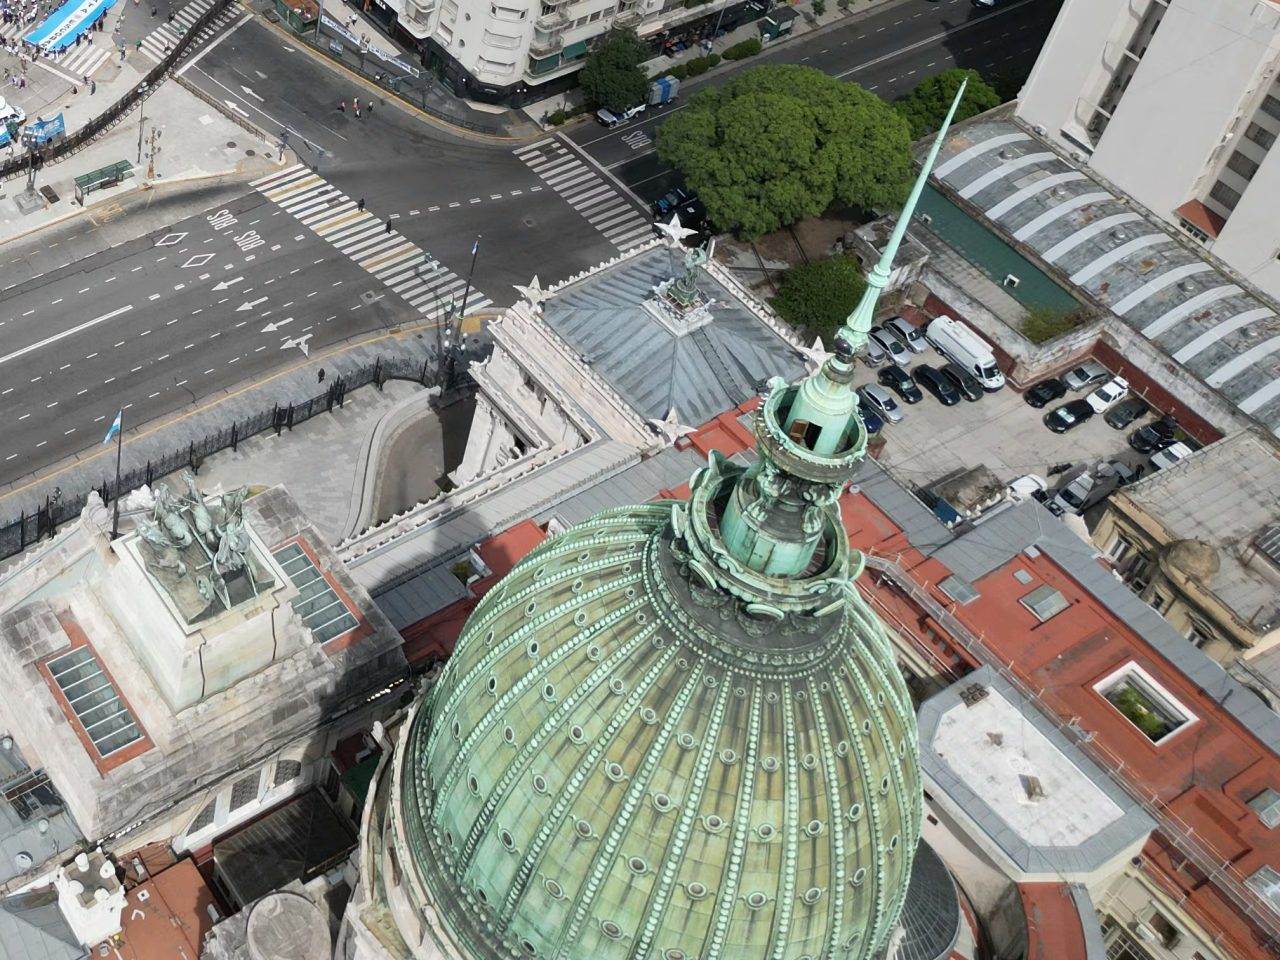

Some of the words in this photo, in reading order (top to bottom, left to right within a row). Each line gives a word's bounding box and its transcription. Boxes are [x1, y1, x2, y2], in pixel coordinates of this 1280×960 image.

[621, 130, 653, 150] BUS
[206, 208, 239, 231] BUS
[233, 229, 266, 252] BUS
